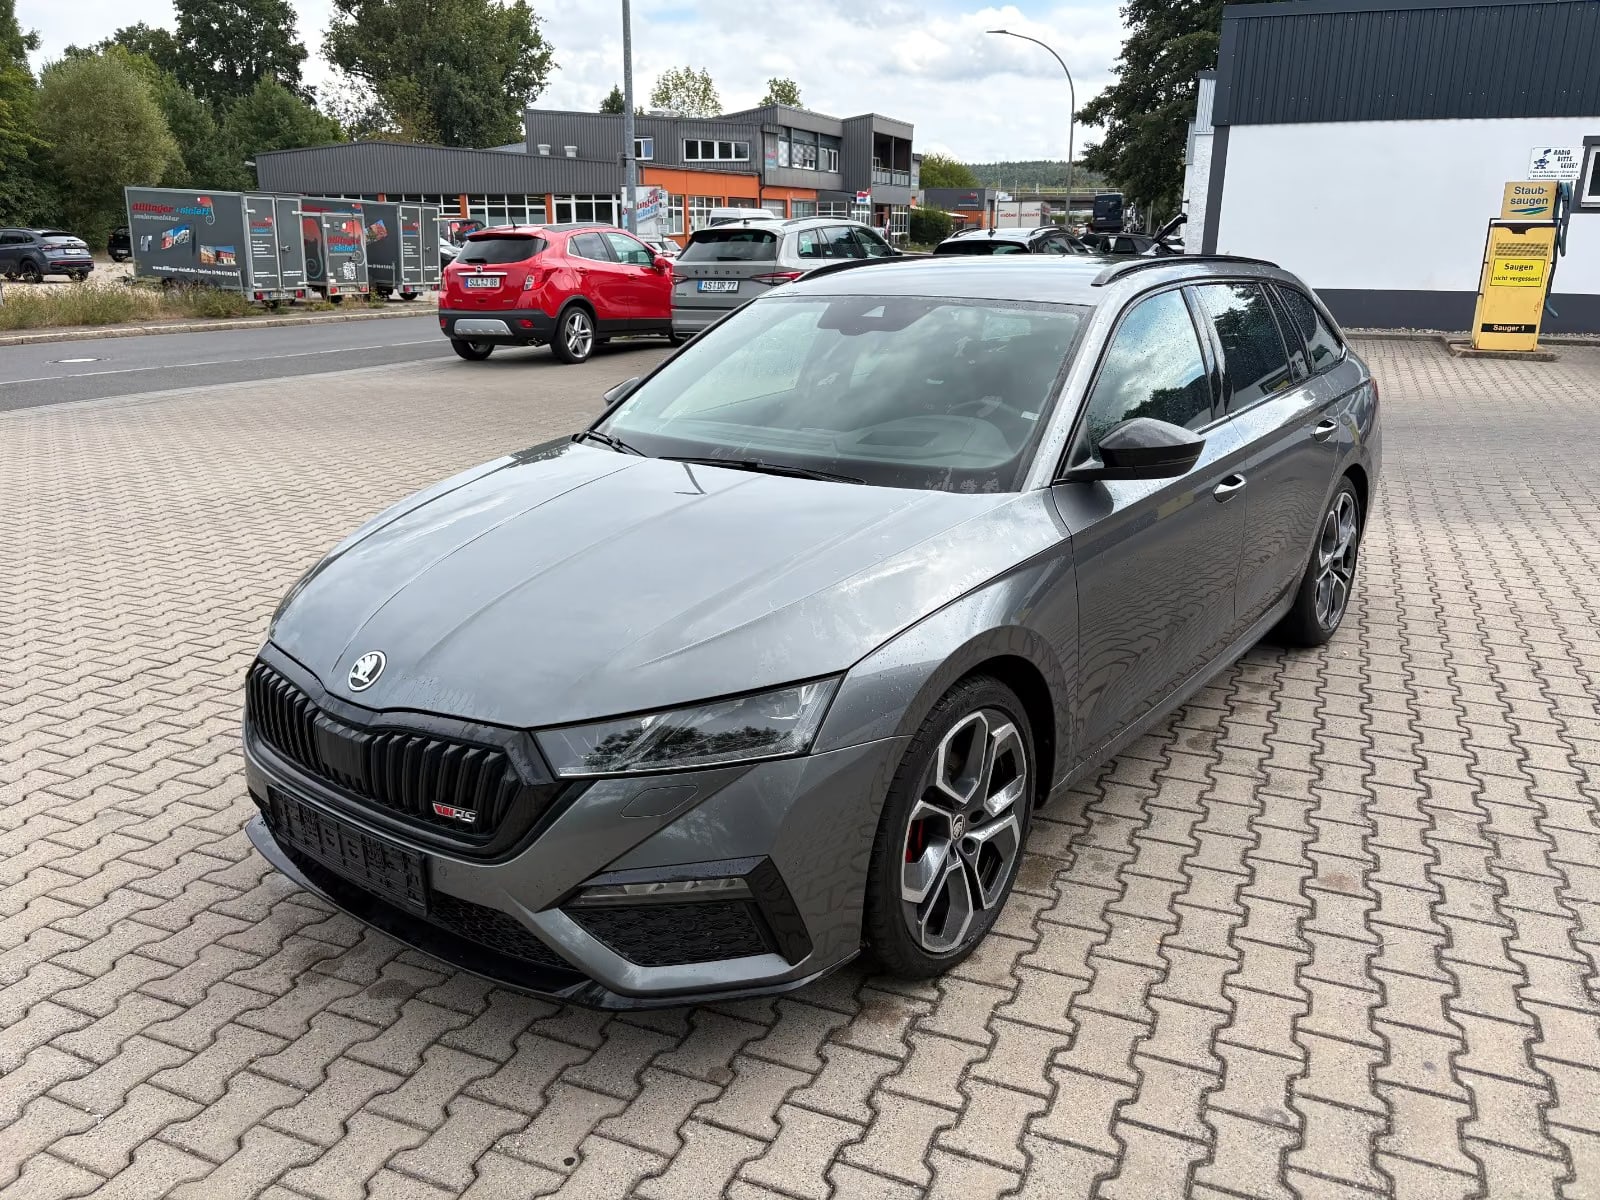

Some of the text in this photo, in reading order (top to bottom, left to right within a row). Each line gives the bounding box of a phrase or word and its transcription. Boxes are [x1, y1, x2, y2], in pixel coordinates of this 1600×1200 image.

[1514, 186, 1548, 195] Staub-
[1510, 197, 1549, 207] saugen
[1503, 262, 1534, 272] Saugen
[728, 281, 738, 290] 77
[1492, 324, 1520, 333] Sauger
